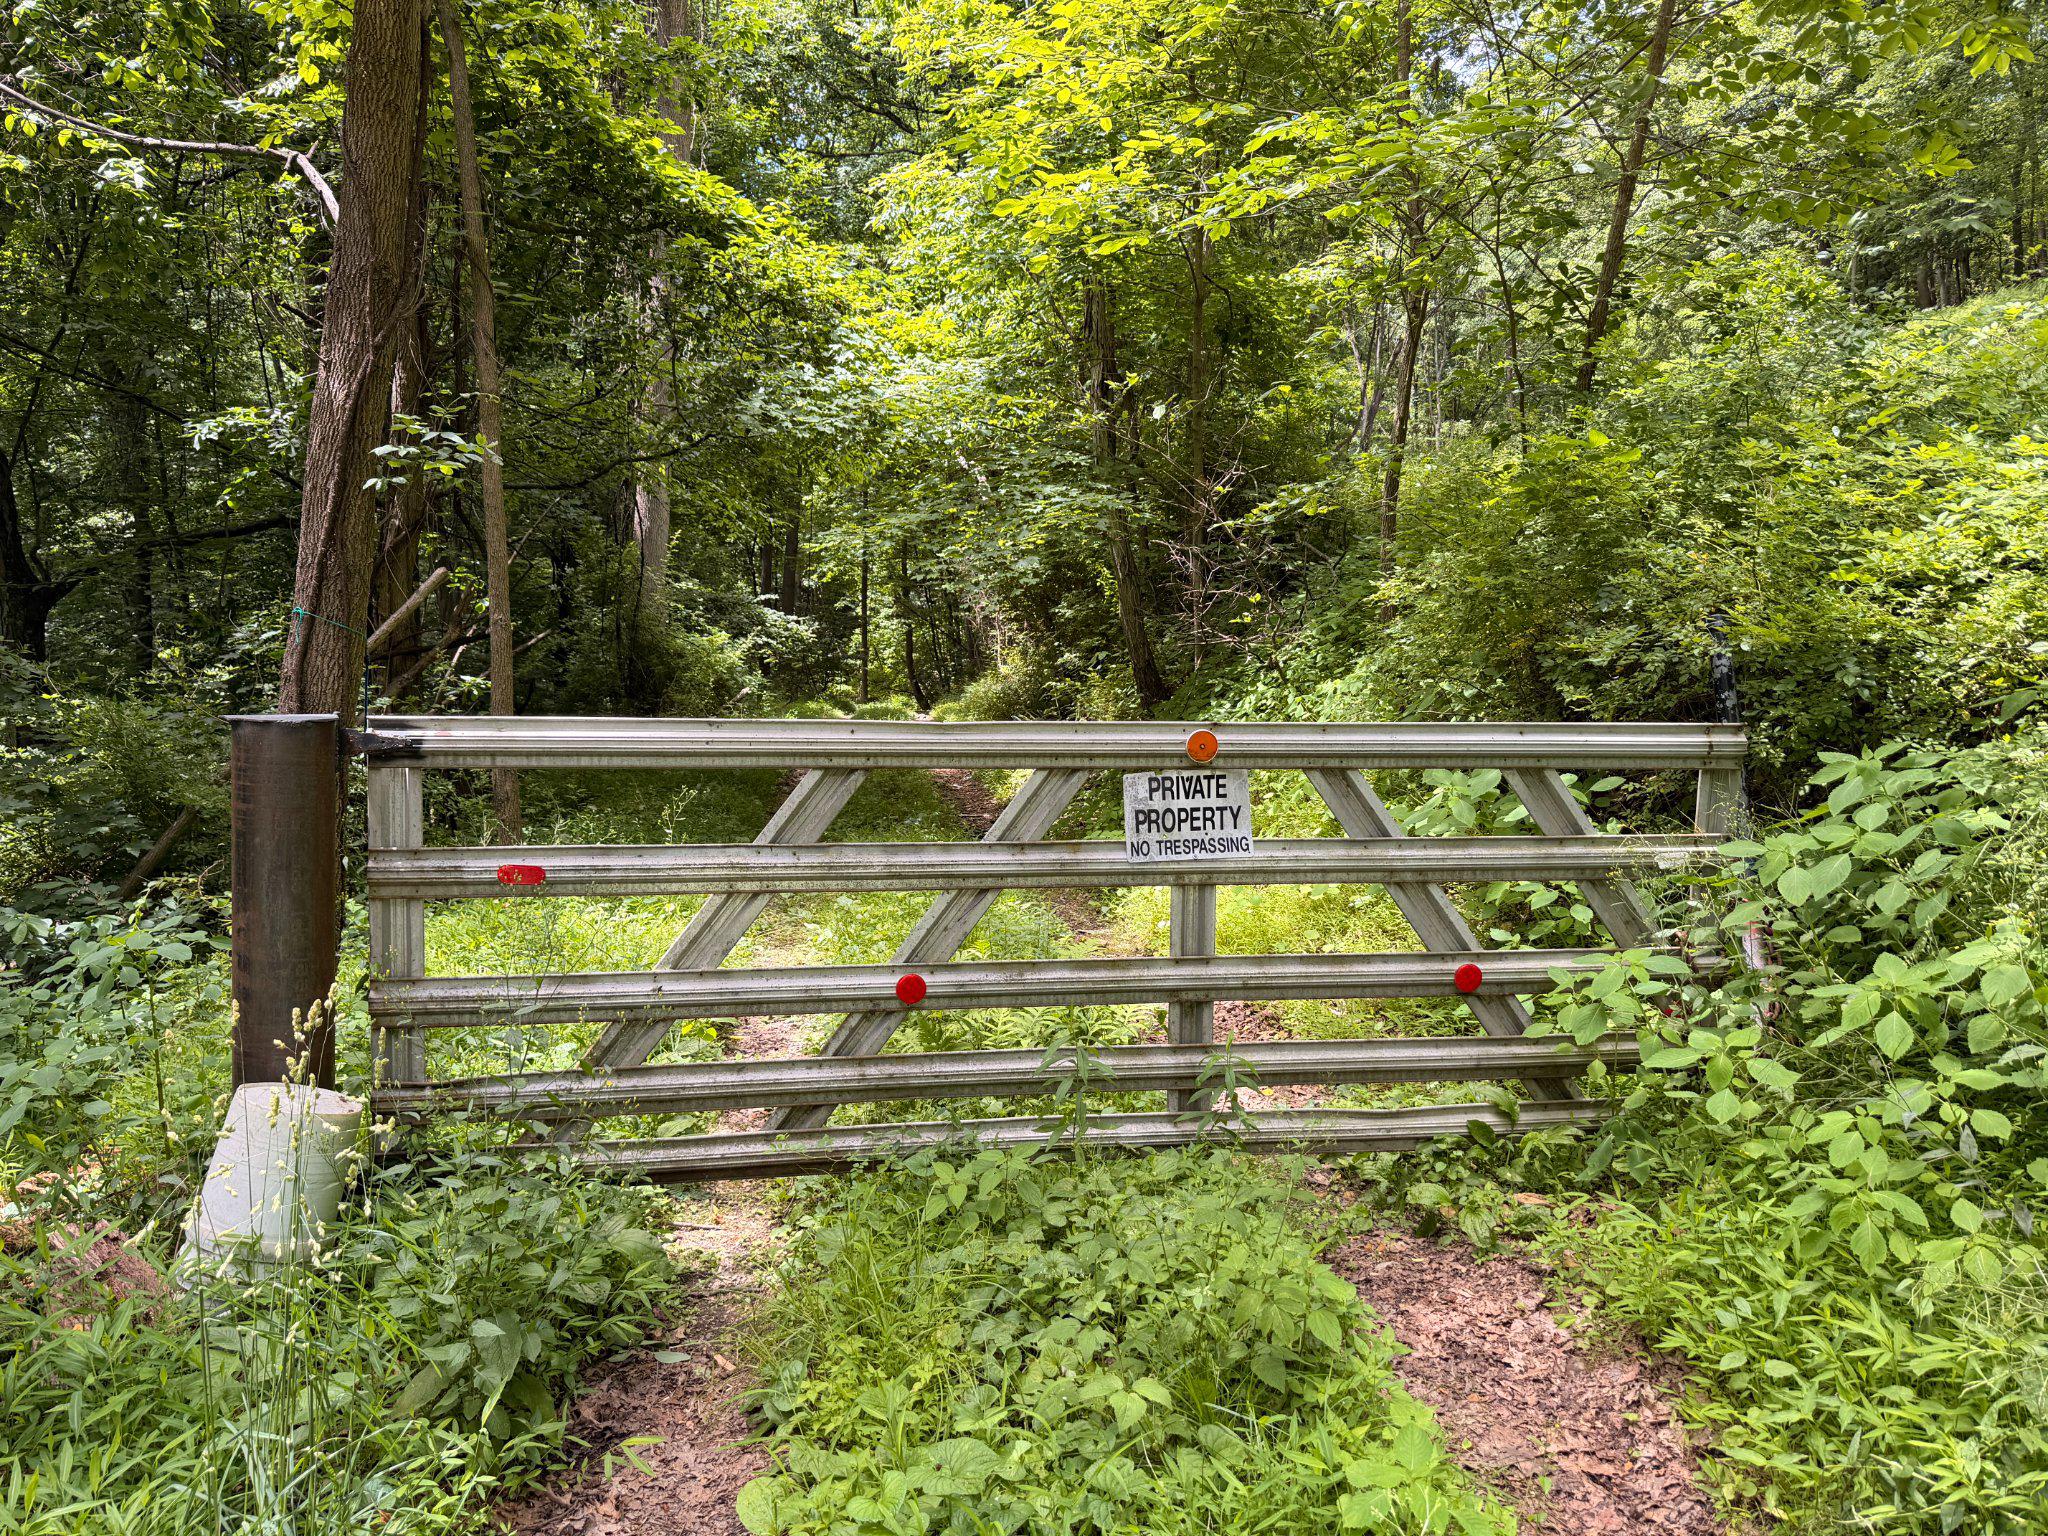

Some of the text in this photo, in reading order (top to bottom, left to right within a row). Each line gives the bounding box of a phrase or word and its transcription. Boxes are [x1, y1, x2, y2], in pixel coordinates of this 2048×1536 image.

[1148, 774, 1227, 801] PRIVATE
[1135, 805, 1241, 833] PROPERTY
[1130, 836, 1249, 857] NO TRESPASSING
